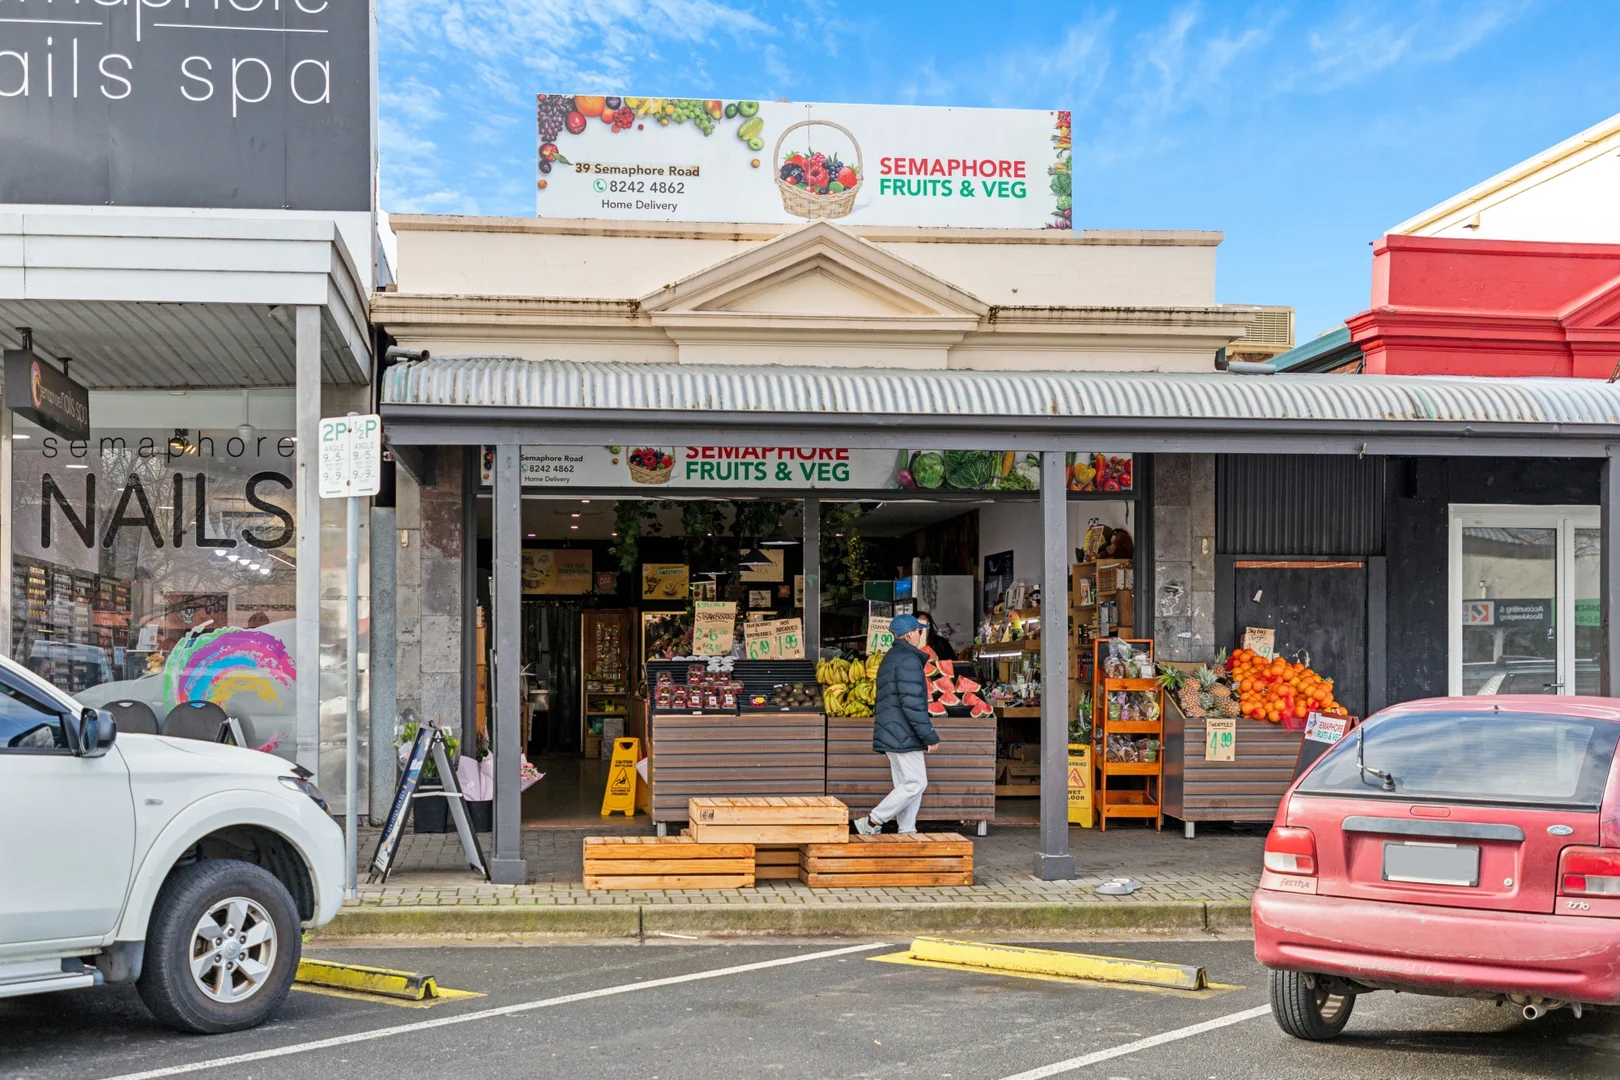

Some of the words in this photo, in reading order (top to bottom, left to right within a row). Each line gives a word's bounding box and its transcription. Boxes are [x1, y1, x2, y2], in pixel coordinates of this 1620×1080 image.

[180, 56, 330, 118] spa
[575, 163, 591, 173] 39
[594, 163, 665, 177] Semaphore
[669, 165, 700, 177] Road
[879, 157, 1026, 178] SEMAPHORE
[609, 181, 645, 193] 8242
[650, 182, 685, 194] 4862
[880, 179, 953, 197] FRUITS
[959, 180, 976, 198] &
[982, 181, 1027, 199] VEG
[601, 199, 633, 209] Home
[636, 200, 678, 212] Delivery
[323, 422, 347, 442] 2P
[42, 430, 295, 465] semaphore
[324, 444, 344, 452] ANGLE
[354, 442, 374, 450] ANGLE
[520, 454, 562, 464] Semaphore
[685, 446, 849, 461] SEMAPHORE
[529, 464, 551, 473] 8242
[553, 465, 575, 473] 4862
[685, 461, 767, 481] FRUITS
[774, 461, 793, 481] &
[799, 462, 850, 482] VEG
[545, 475, 570, 483] Delivery
[41, 471, 294, 549] NAILS
[1318, 721, 1344, 733] EMAPHORE
